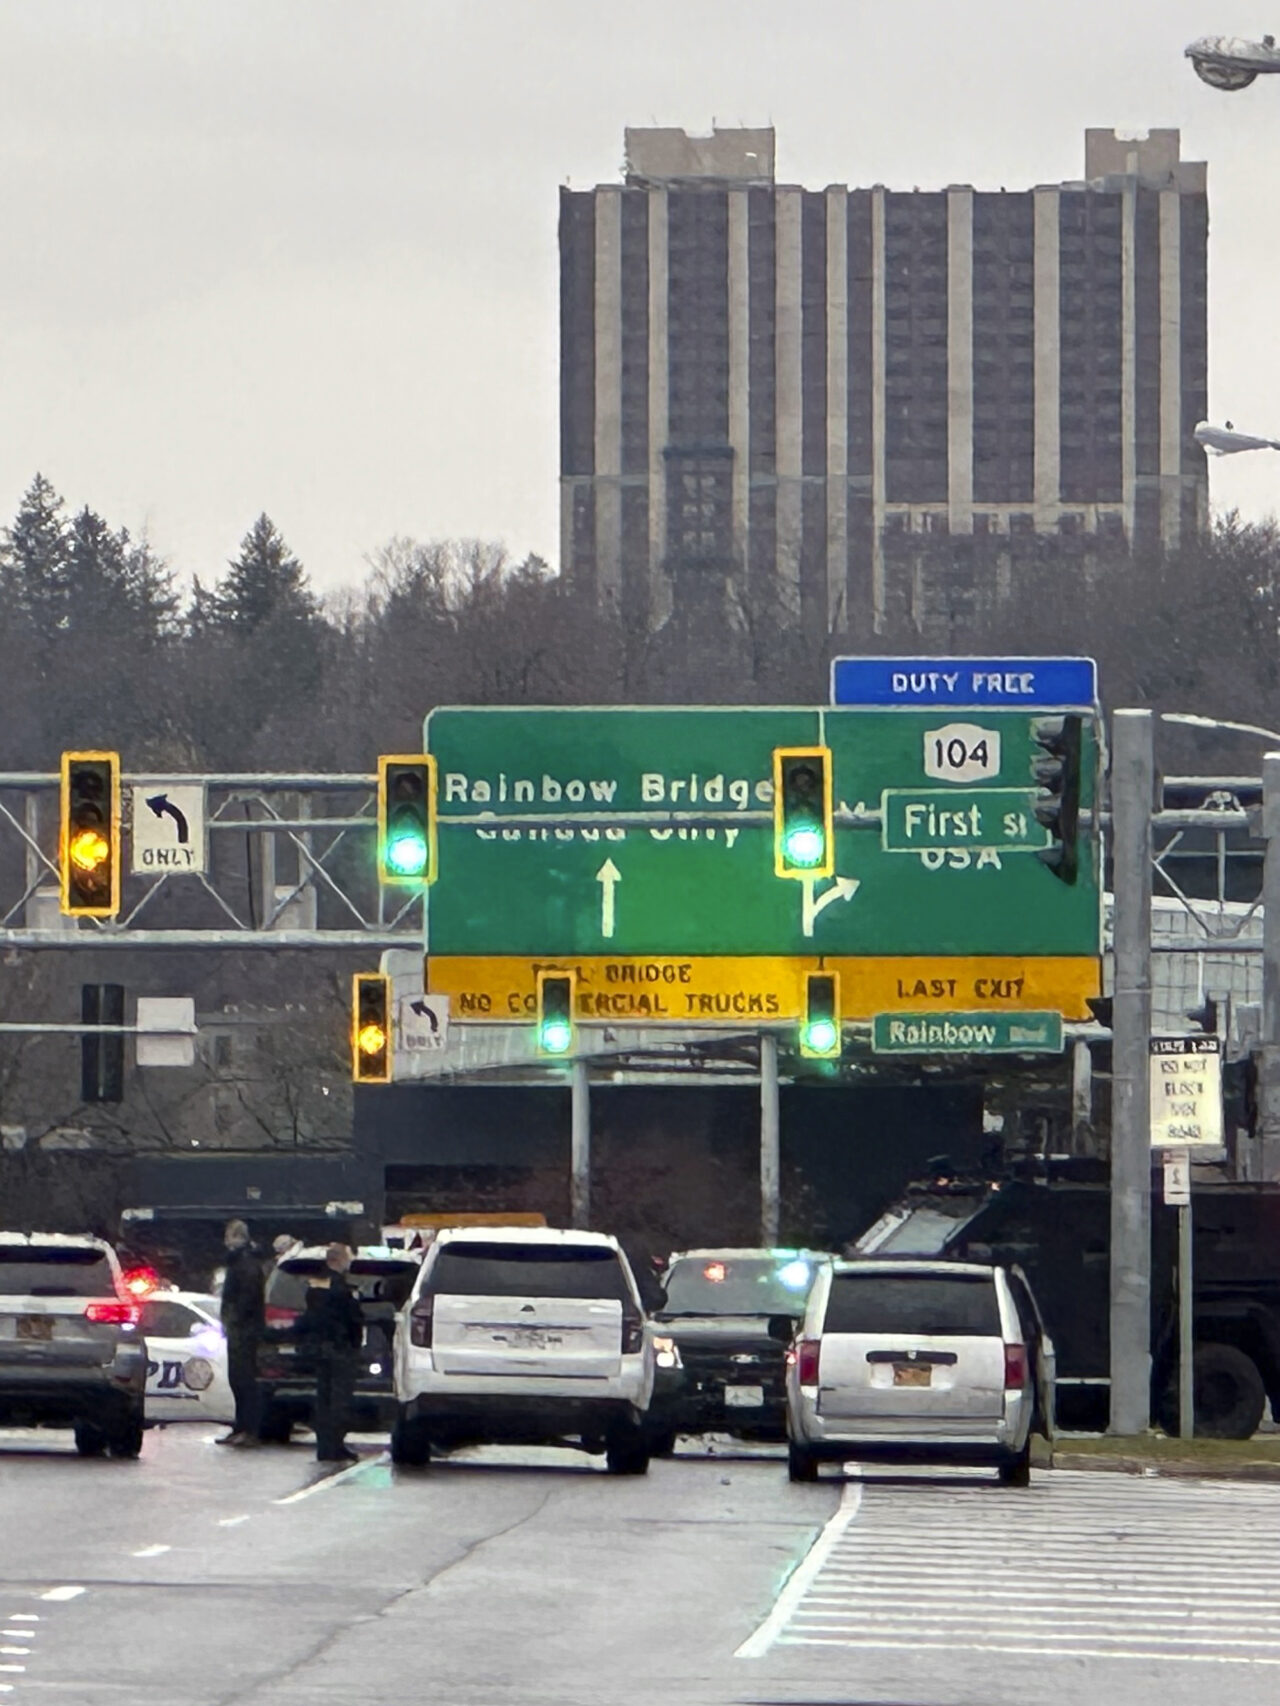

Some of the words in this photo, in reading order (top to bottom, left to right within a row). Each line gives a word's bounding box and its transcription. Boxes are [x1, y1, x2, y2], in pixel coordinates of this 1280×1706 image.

[892, 672, 960, 695] DUTY
[972, 673, 1036, 695] FREE
[934, 738, 989, 769] 104
[445, 772, 618, 803] Rainbow
[641, 772, 774, 810] Bridge
[905, 803, 982, 839] First
[142, 847, 195, 866] ONLY
[605, 963, 693, 985] BRIDGE
[896, 978, 957, 999] LAST
[974, 977, 1026, 999] EXIT
[459, 993, 492, 1013] NO
[508, 992, 668, 1014] COERCIAL
[684, 992, 780, 1014] TRUCKS
[889, 1020, 997, 1045] Rainbow
